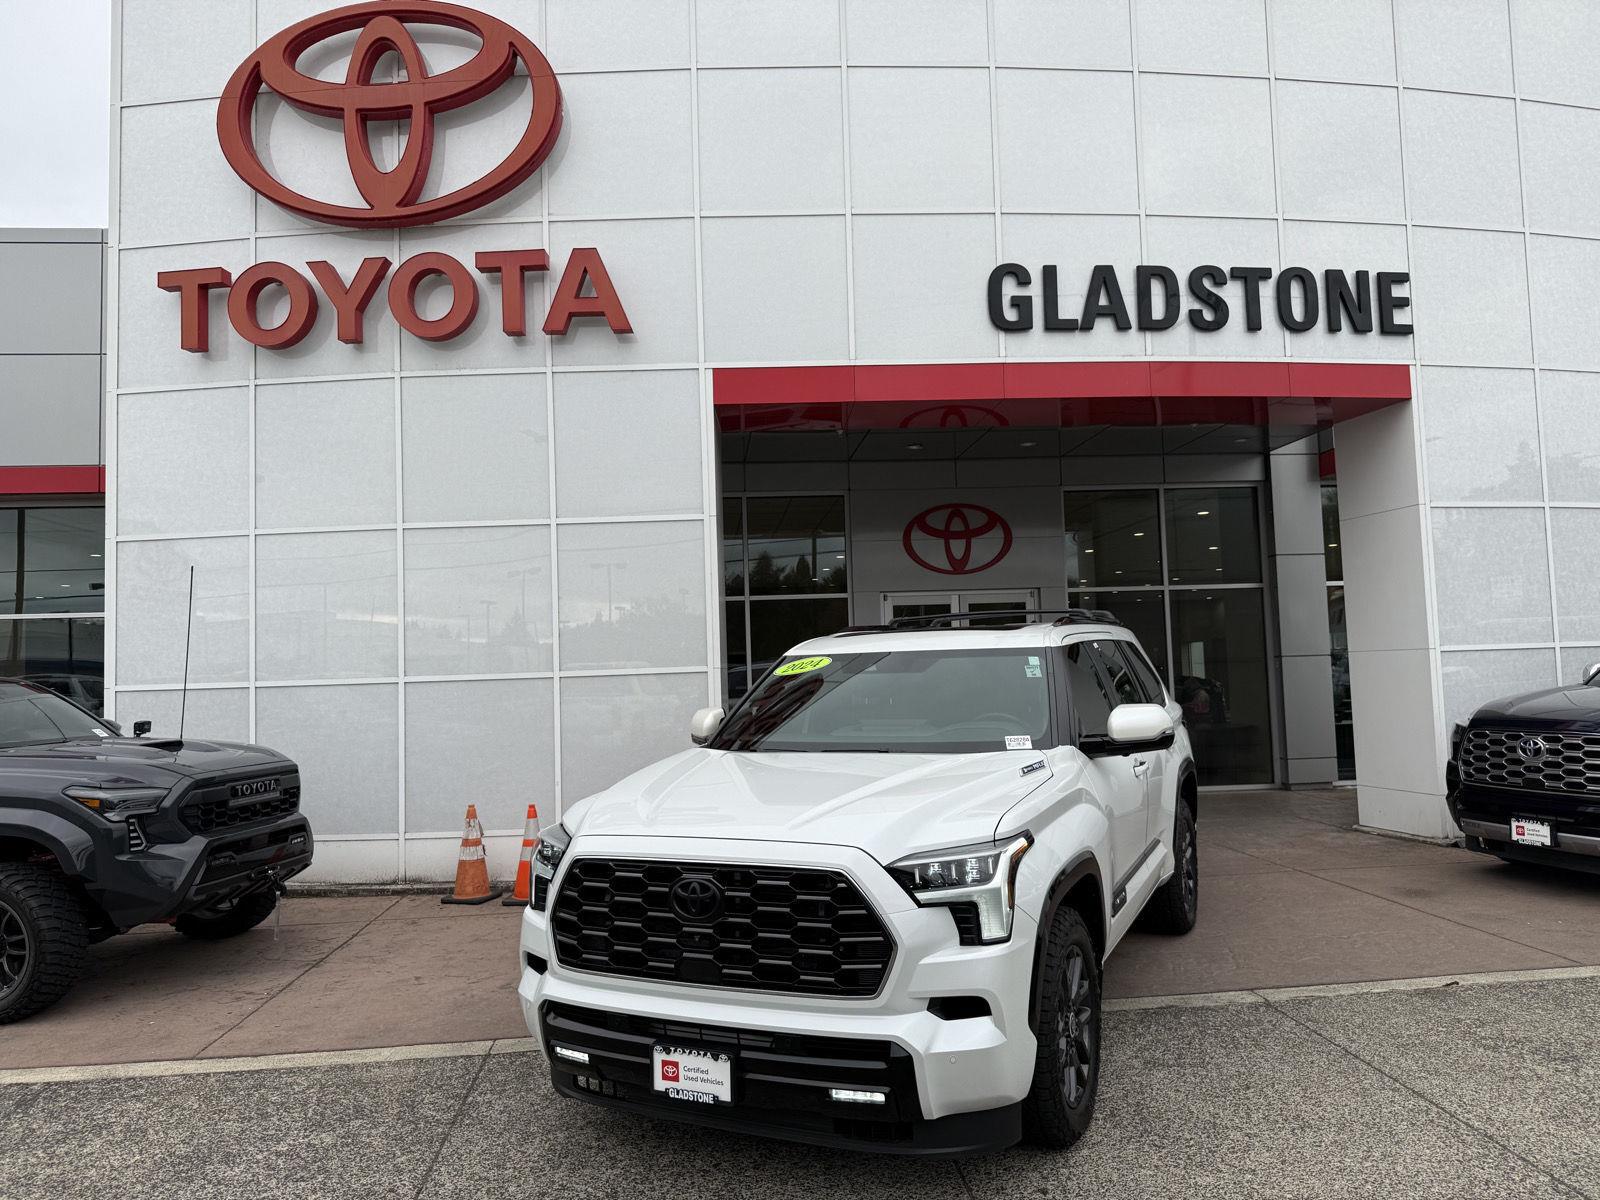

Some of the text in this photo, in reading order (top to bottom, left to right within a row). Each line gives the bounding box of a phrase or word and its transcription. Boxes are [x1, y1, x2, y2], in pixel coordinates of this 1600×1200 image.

[157, 247, 633, 353] TOYOTA
[988, 263, 1413, 335] GLADSTONE
[780, 658, 824, 674] 2024
[235, 780, 277, 796] TOYOTA
[669, 1047, 713, 1059] TOYOTA
[683, 1065, 709, 1075] Certified
[683, 1074, 724, 1086] Used Vehicles
[668, 1087, 714, 1104] GLADSTONE
